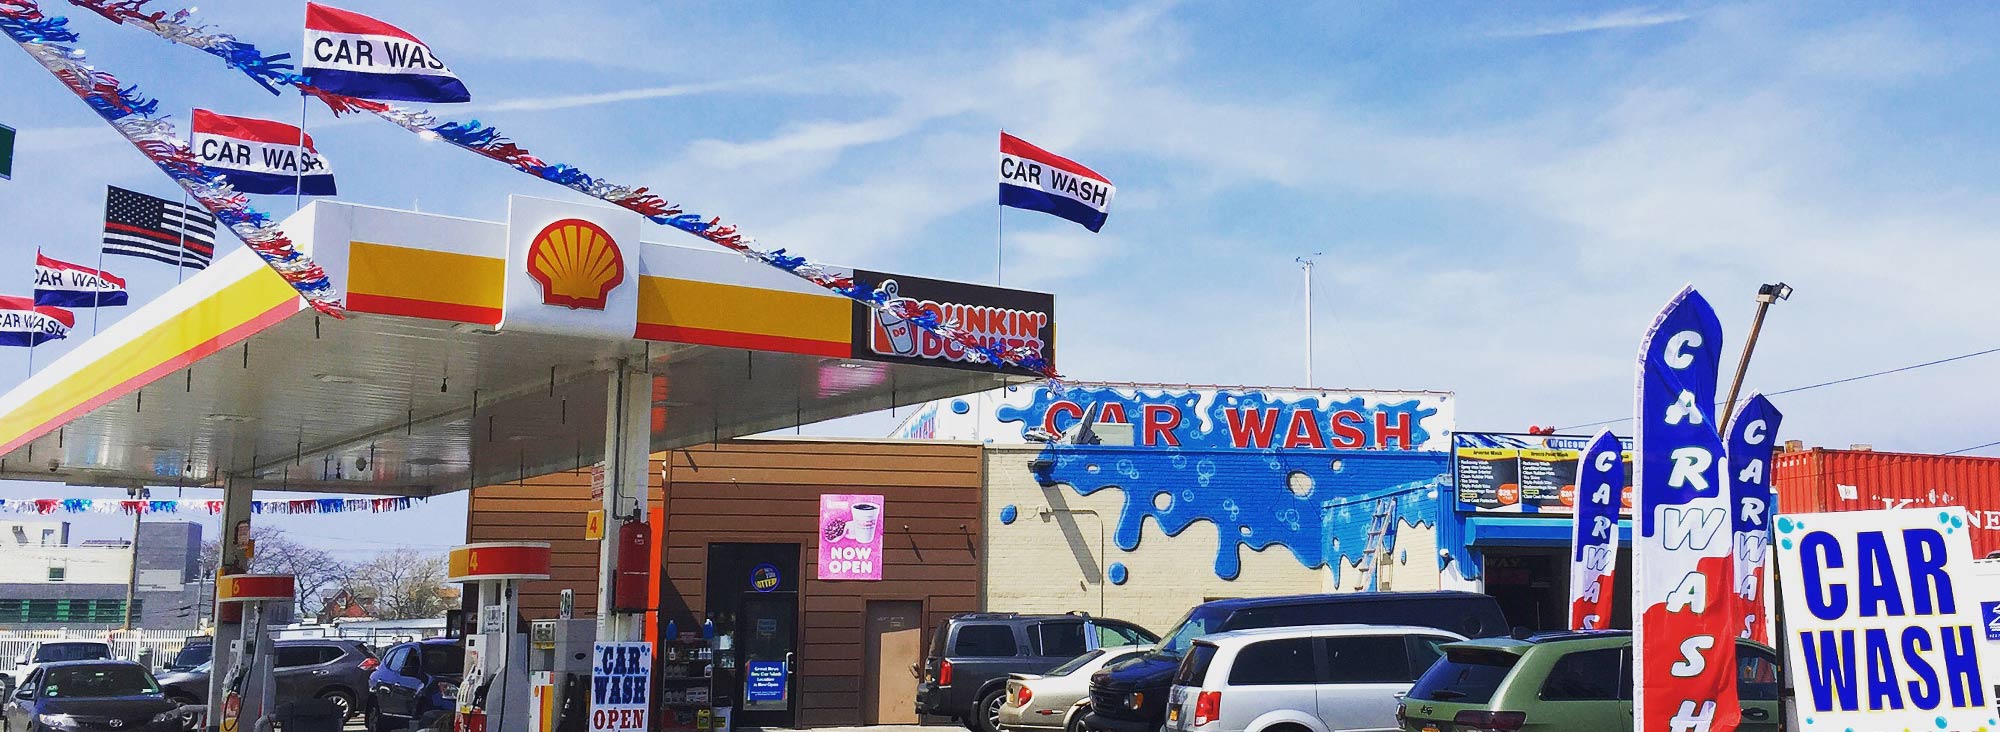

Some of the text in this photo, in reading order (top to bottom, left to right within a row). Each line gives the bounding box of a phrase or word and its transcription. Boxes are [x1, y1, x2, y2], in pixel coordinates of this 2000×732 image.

[314, 37, 450, 72] CAR WAS
[202, 139, 251, 166] CAR
[1001, 157, 1108, 206] CAR WASH
[71, 272, 118, 290] WAS
[24, 314, 67, 341] WASH
[1225, 406, 1412, 450] WASH
[1550, 439, 1589, 449] Welcom
[590, 516, 597, 533] 4
[1662, 330, 1726, 732] CAR WASH
[1738, 419, 1767, 639] CAR WAS
[1967, 510, 2000, 530] NE
[830, 547, 872, 560] NOW
[1581, 451, 1617, 630] CAR WAS
[469, 551, 478, 571] 4
[829, 560, 873, 574] OPEN
[233, 580, 240, 594] 6
[1799, 528, 1957, 622] CAR
[602, 646, 641, 675] CAR
[1799, 625, 1986, 712] WASH
[594, 676, 647, 704] WASH
[593, 709, 645, 730] OPEN
